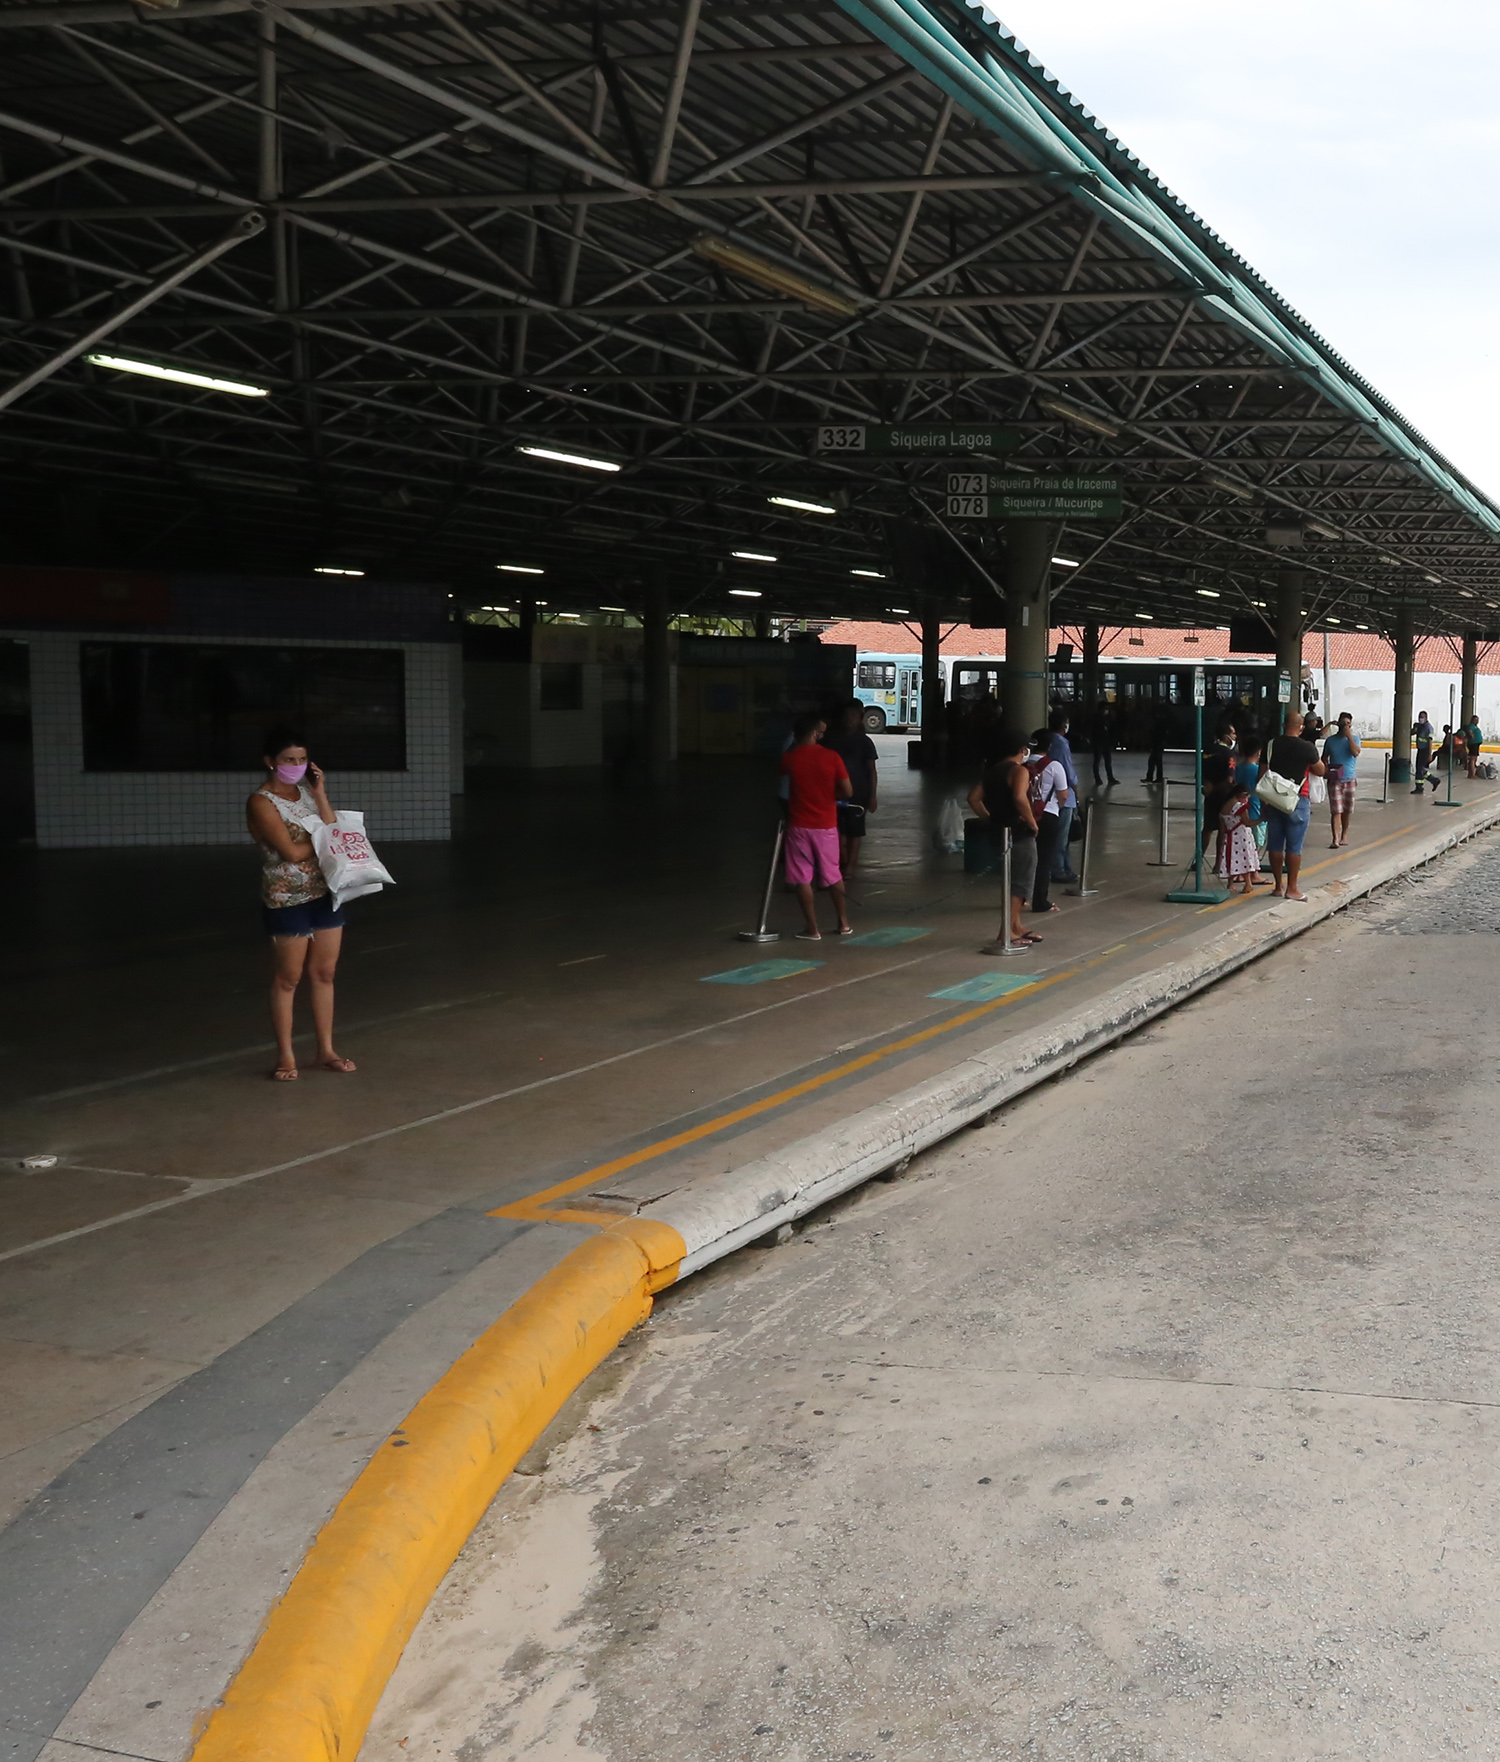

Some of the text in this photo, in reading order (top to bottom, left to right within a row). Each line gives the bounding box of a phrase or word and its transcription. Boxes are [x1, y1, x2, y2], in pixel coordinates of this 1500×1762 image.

[822, 429, 992, 449] 332 Siqueira Lagoa
[949, 475, 1117, 493] 073 Siqueira Praia de Iracema
[950, 497, 983, 515] 078
[1003, 497, 1045, 509] Siqueira
[1055, 497, 1104, 510] Mucuripe
